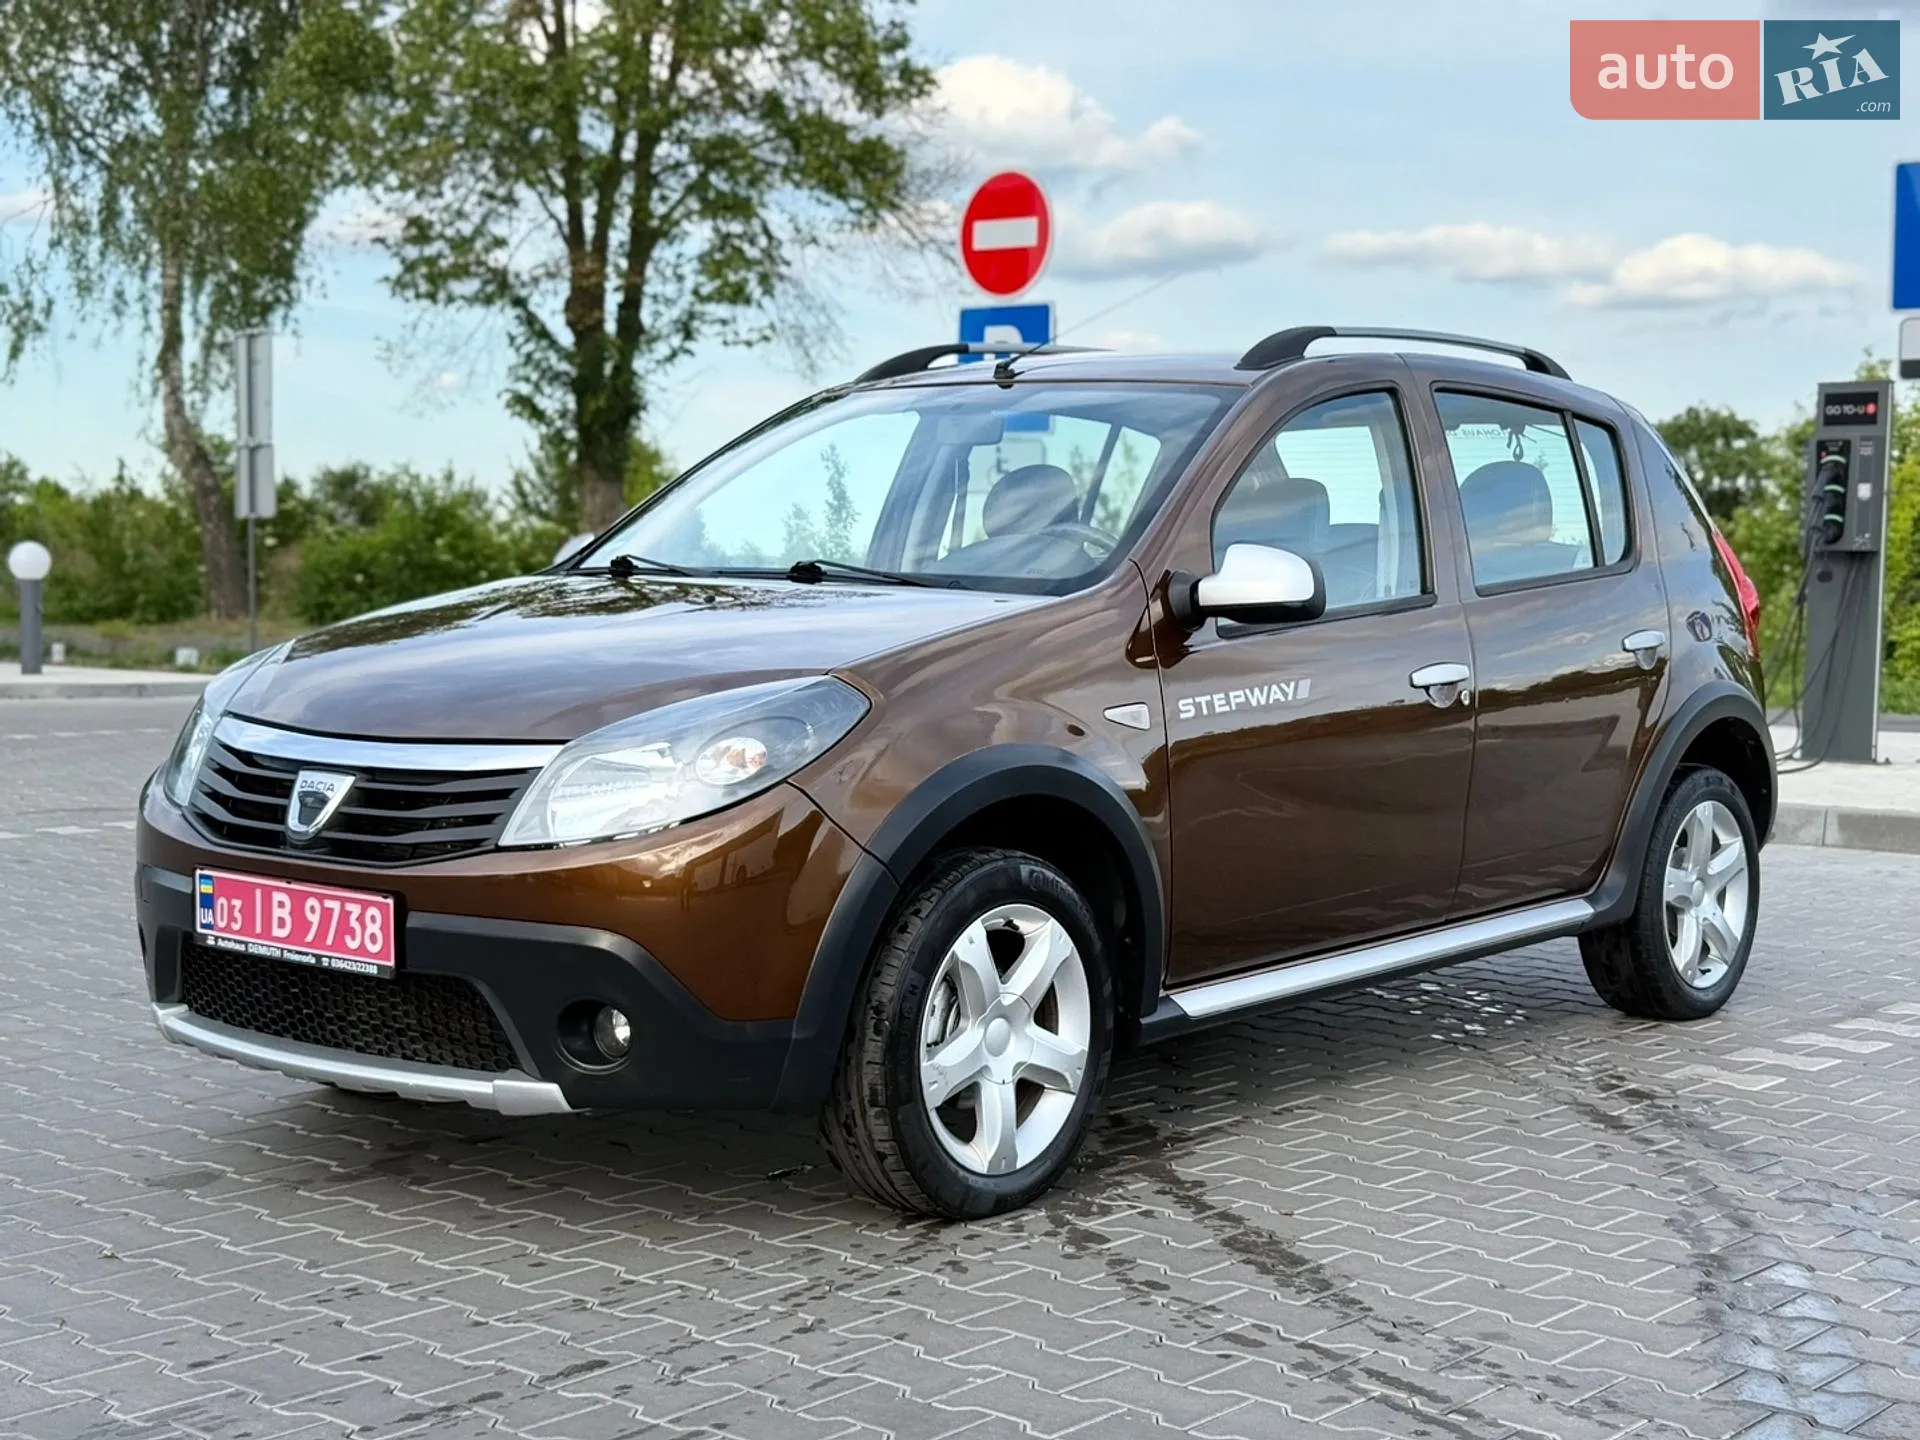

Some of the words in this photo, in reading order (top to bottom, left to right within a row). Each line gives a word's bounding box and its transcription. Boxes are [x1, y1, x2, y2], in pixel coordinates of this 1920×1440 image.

[1177, 680, 1295, 719] STEPWAY
[299, 779, 335, 792] DACIA
[200, 907, 214, 925] UA
[216, 896, 243, 931] 03
[254, 887, 293, 939] IB
[304, 896, 384, 954] 9738
